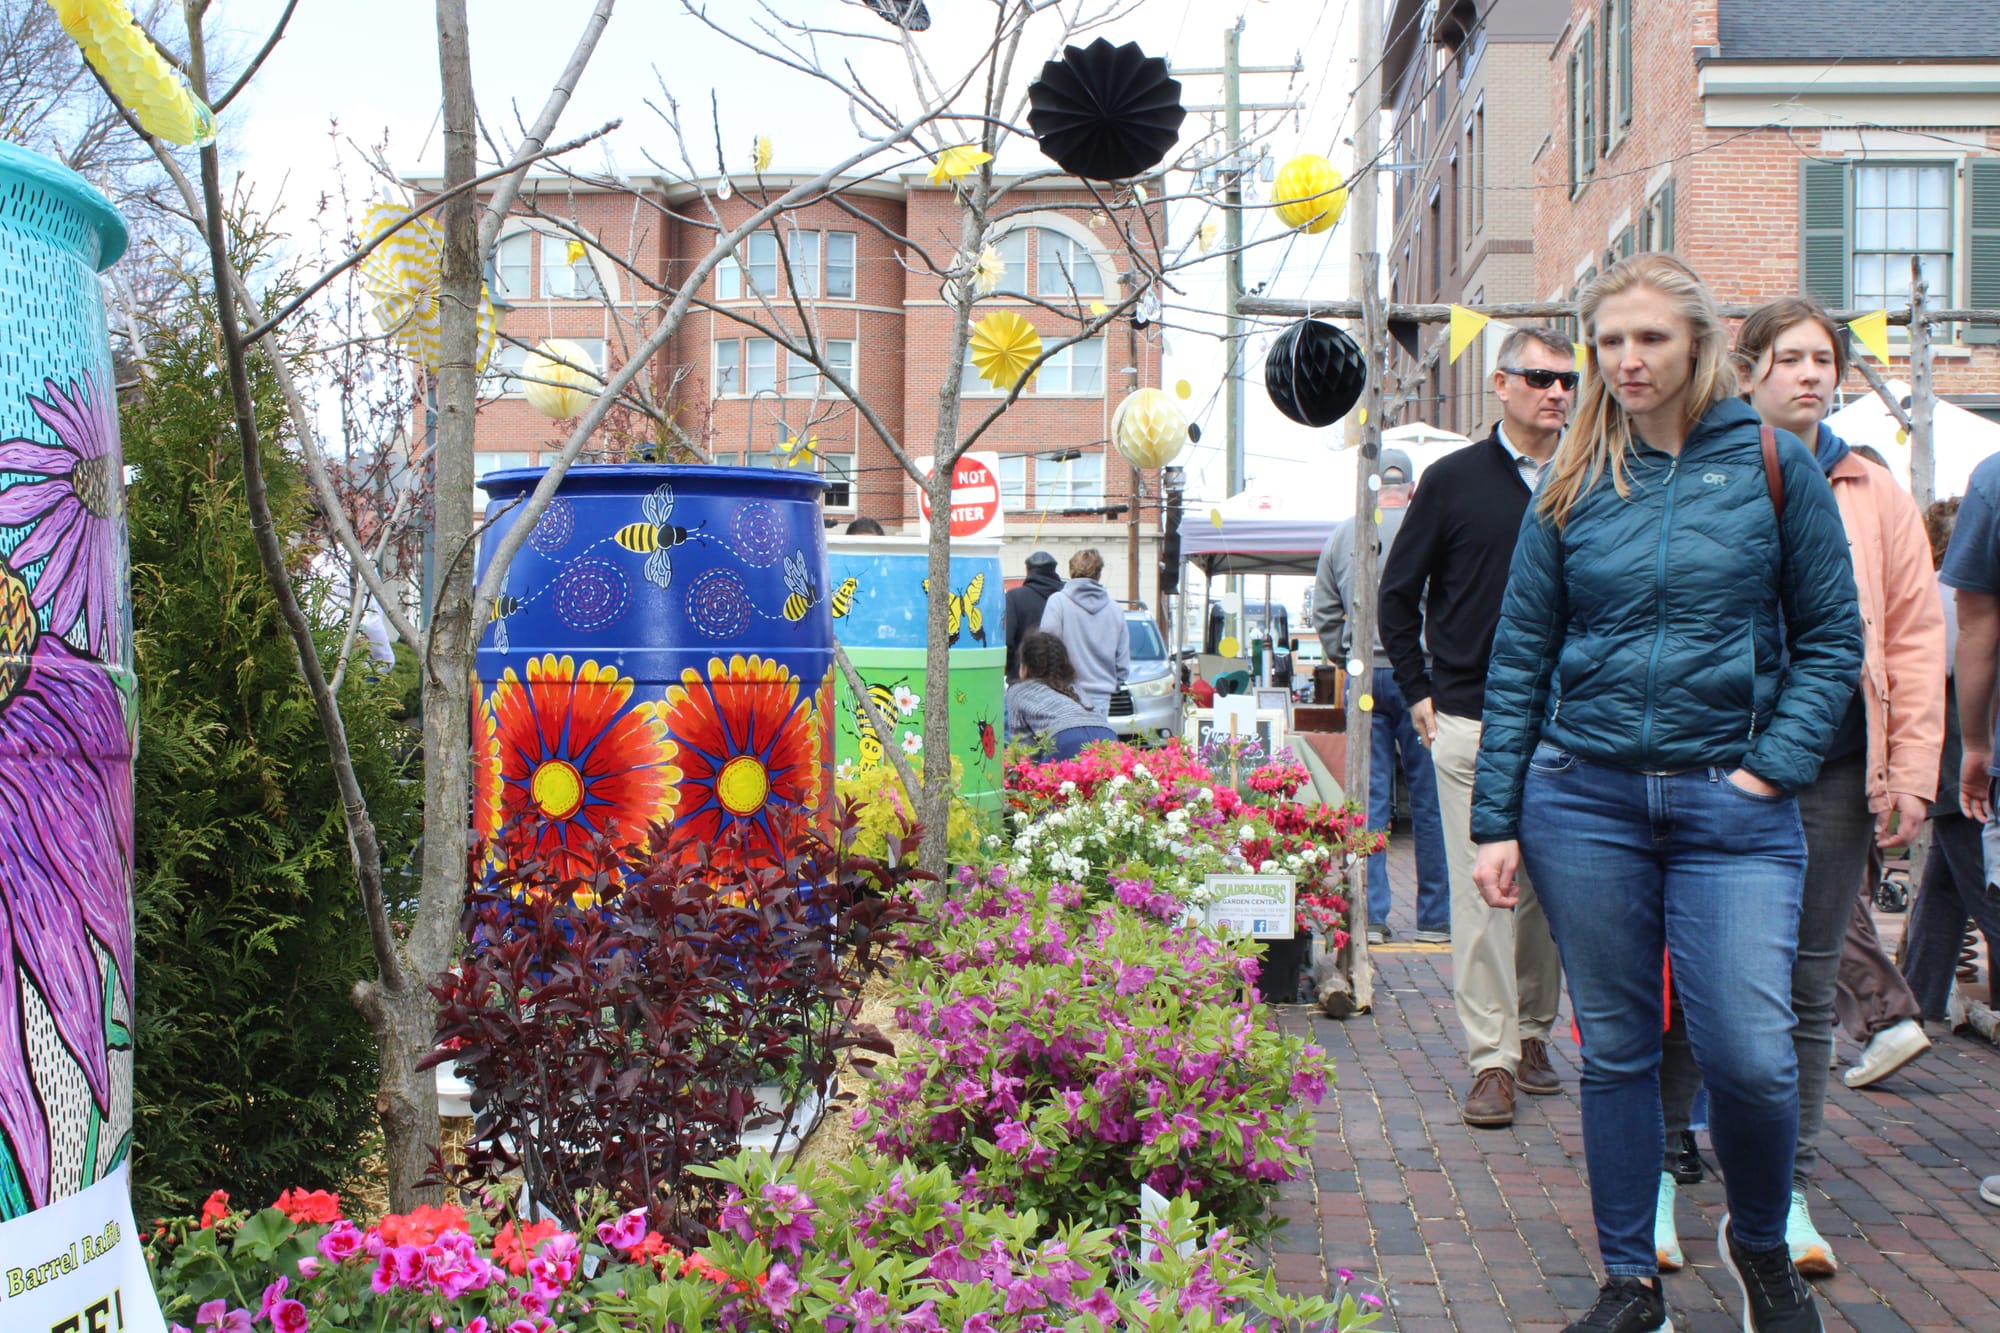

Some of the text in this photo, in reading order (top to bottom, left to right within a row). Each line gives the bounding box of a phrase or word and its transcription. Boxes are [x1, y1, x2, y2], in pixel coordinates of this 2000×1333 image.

[958, 469, 986, 485] NOT
[1702, 472, 1727, 486] OR
[950, 506, 984, 522] NTER
[6, 1219, 121, 1297] Barrel Raffle
